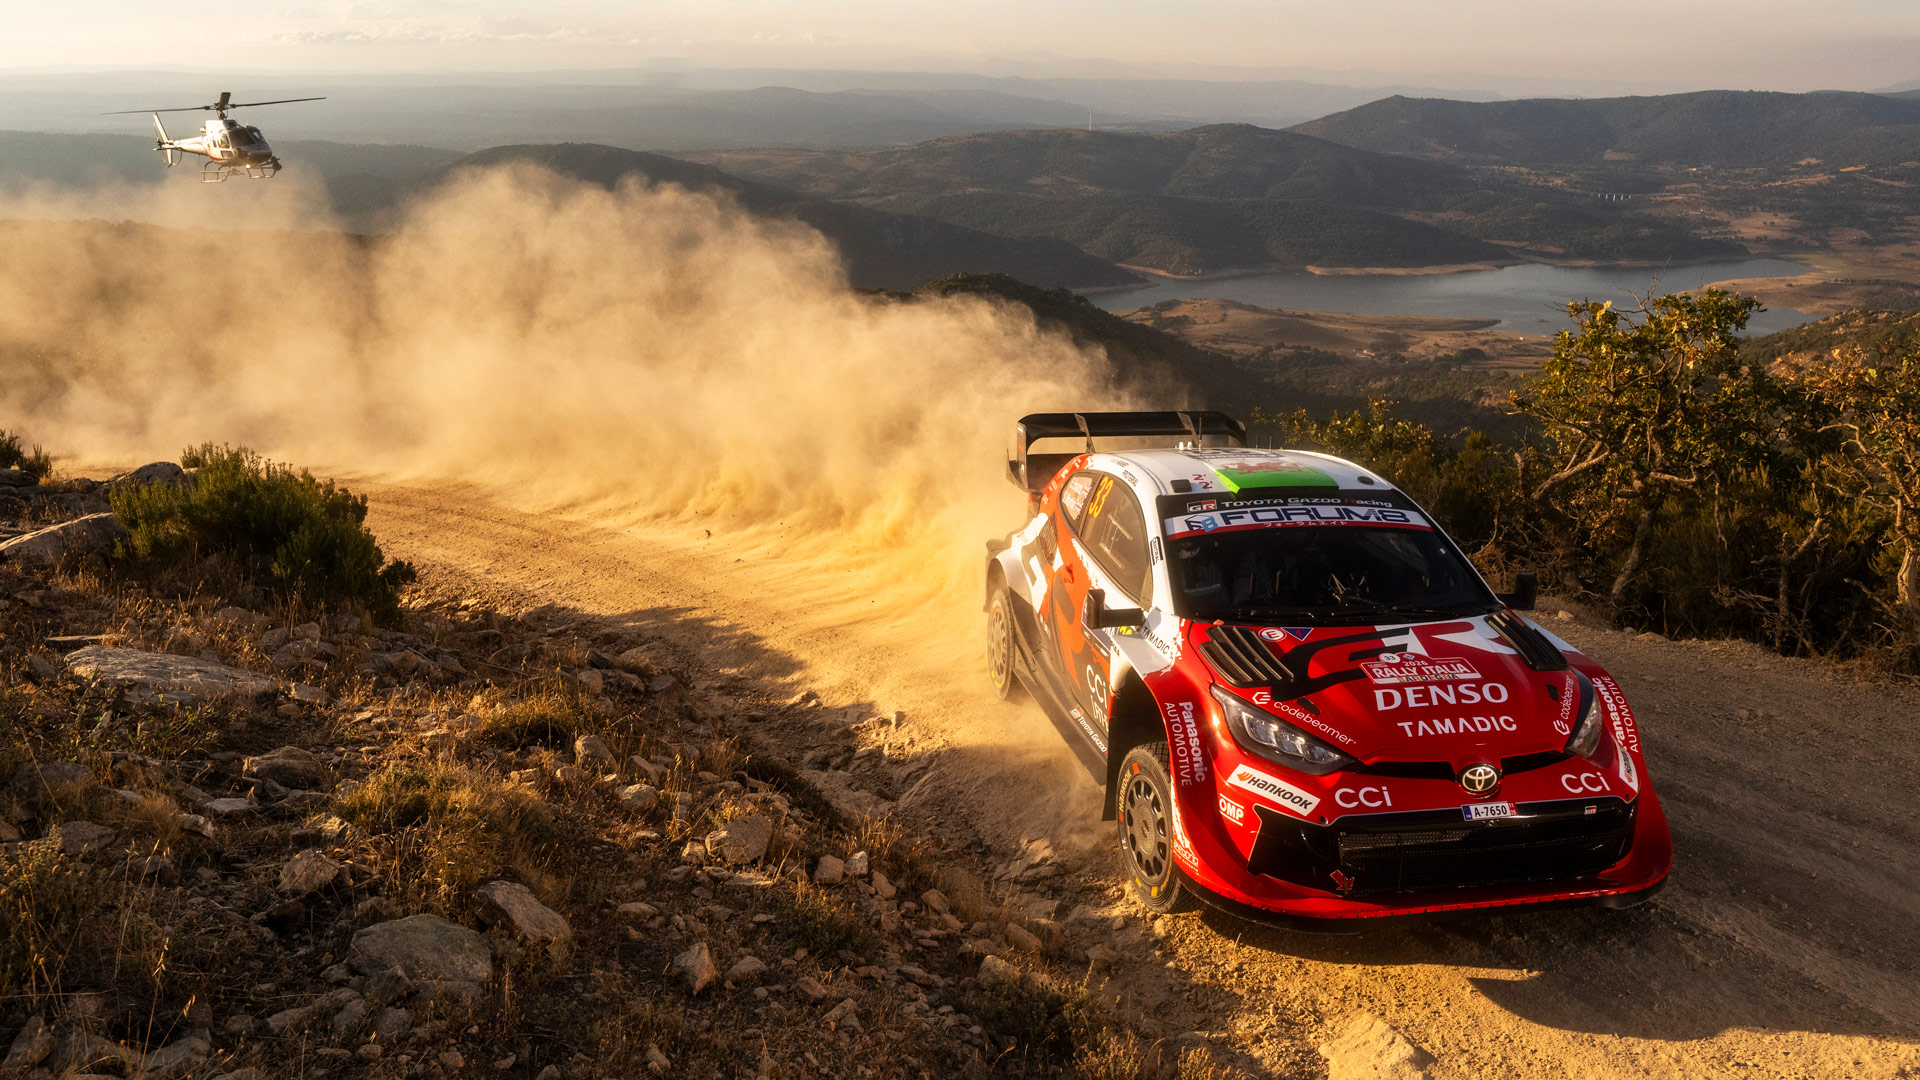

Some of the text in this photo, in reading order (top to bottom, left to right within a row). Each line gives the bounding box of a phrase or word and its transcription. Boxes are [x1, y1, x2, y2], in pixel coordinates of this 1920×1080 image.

[1088, 475, 1114, 518] 33
[1188, 502, 1217, 512] GR
[1221, 498, 1284, 508] TOYOTA
[1344, 498, 1393, 508] Racing
[1220, 507, 1411, 526] FORUM8
[1143, 626, 1170, 655] TAMADIC
[1372, 663, 1472, 679] RALLY ITALIA
[1373, 682, 1509, 711] DENSO
[1273, 701, 1355, 746] codebeamer
[1601, 675, 1640, 753] AUTOMOTIVE
[1078, 716, 1095, 736] TOYOTA
[1397, 716, 1518, 738] TAMADIC
[1164, 702, 1193, 787] AUTOMOTIVE
[1178, 701, 1208, 782] Panasonic
[1219, 798, 1245, 821] OMP
[1474, 804, 1508, 818] A-7650
